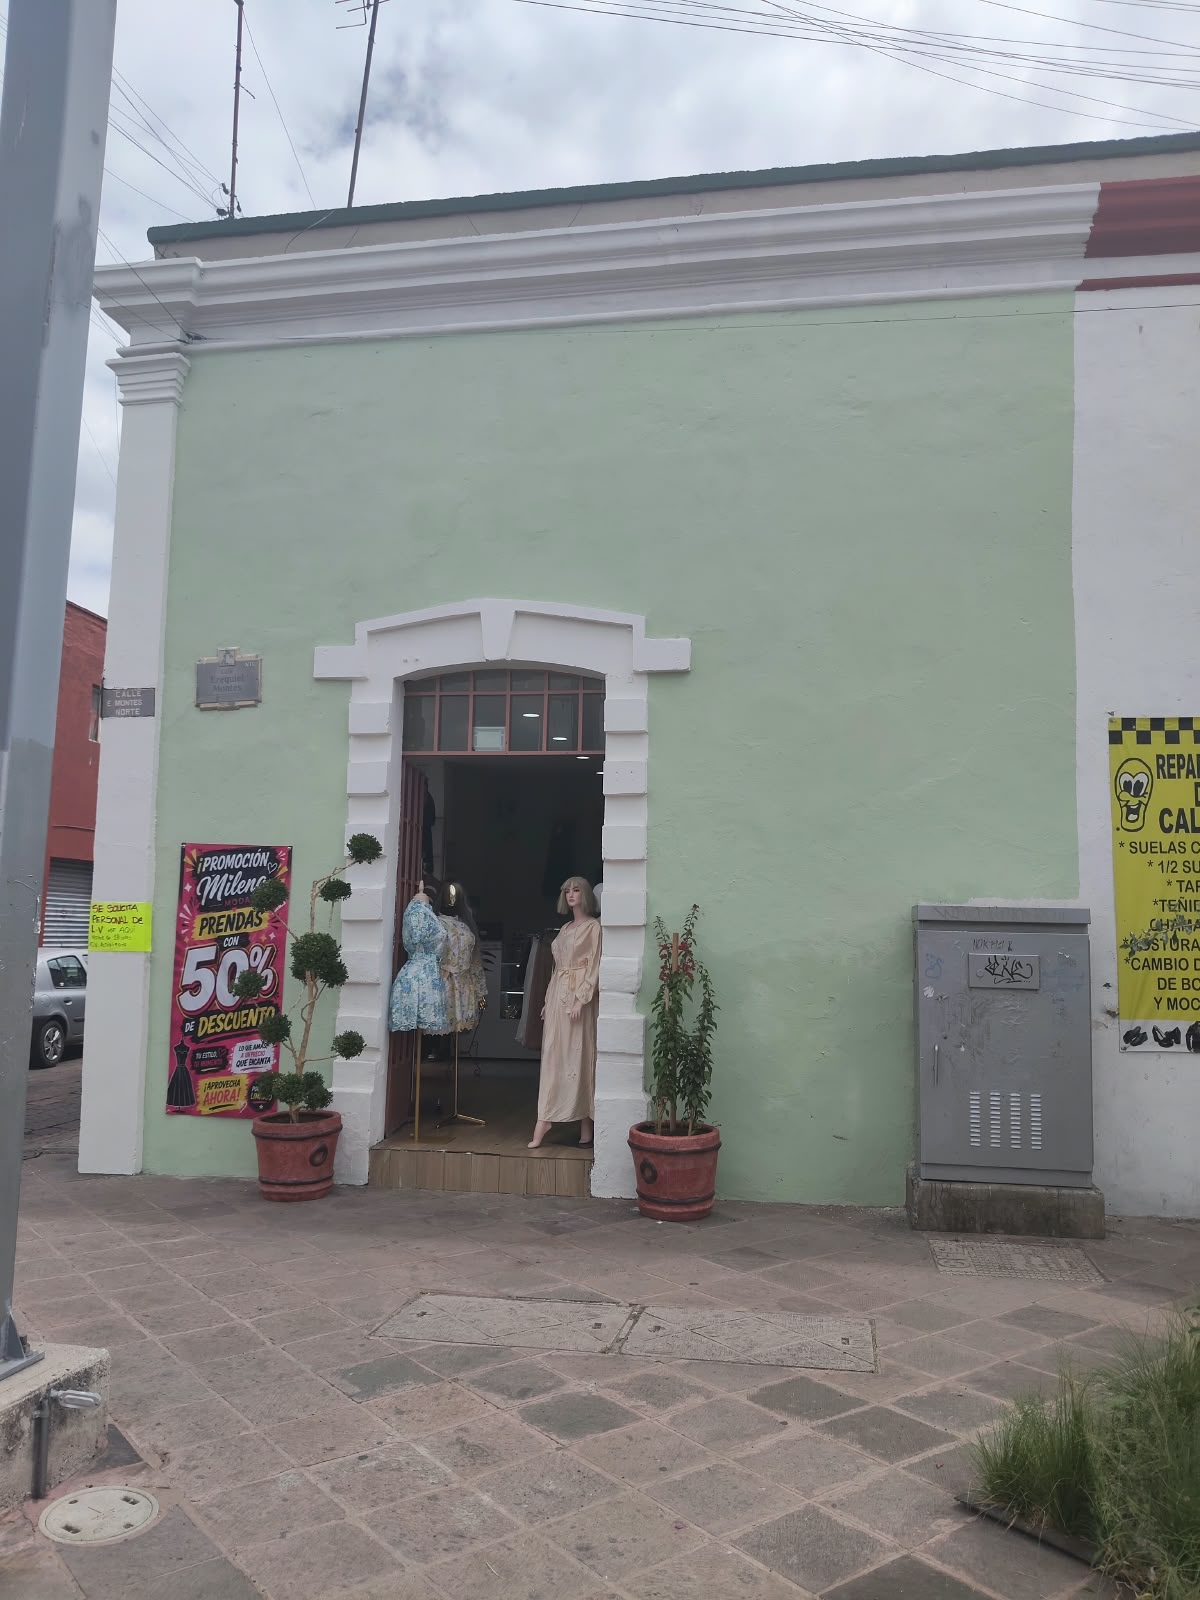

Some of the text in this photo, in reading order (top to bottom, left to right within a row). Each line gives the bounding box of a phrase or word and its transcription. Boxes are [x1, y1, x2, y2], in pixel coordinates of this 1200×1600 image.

[115, 690, 142, 698] CALLE
[114, 699, 142, 707] MONTES
[115, 708, 141, 716] NORTE
[1129, 841, 1187, 855] SUELAS
[1157, 860, 1179, 874] 1/2
[92, 904, 104, 913] SE
[92, 914, 144, 925] PERSONAL DE
[199, 910, 264, 937] PRENDAS
[223, 935, 240, 947] CON
[1130, 957, 1190, 971] CAMBIO
[178, 944, 274, 1012] 50%
[1157, 977, 1177, 991] DE
[1153, 996, 1200, 1011] Y MOC
[184, 1021, 196, 1033] DE
[236, 1059, 248, 1068] QUE
[203, 1088, 241, 1106] AHORA!
